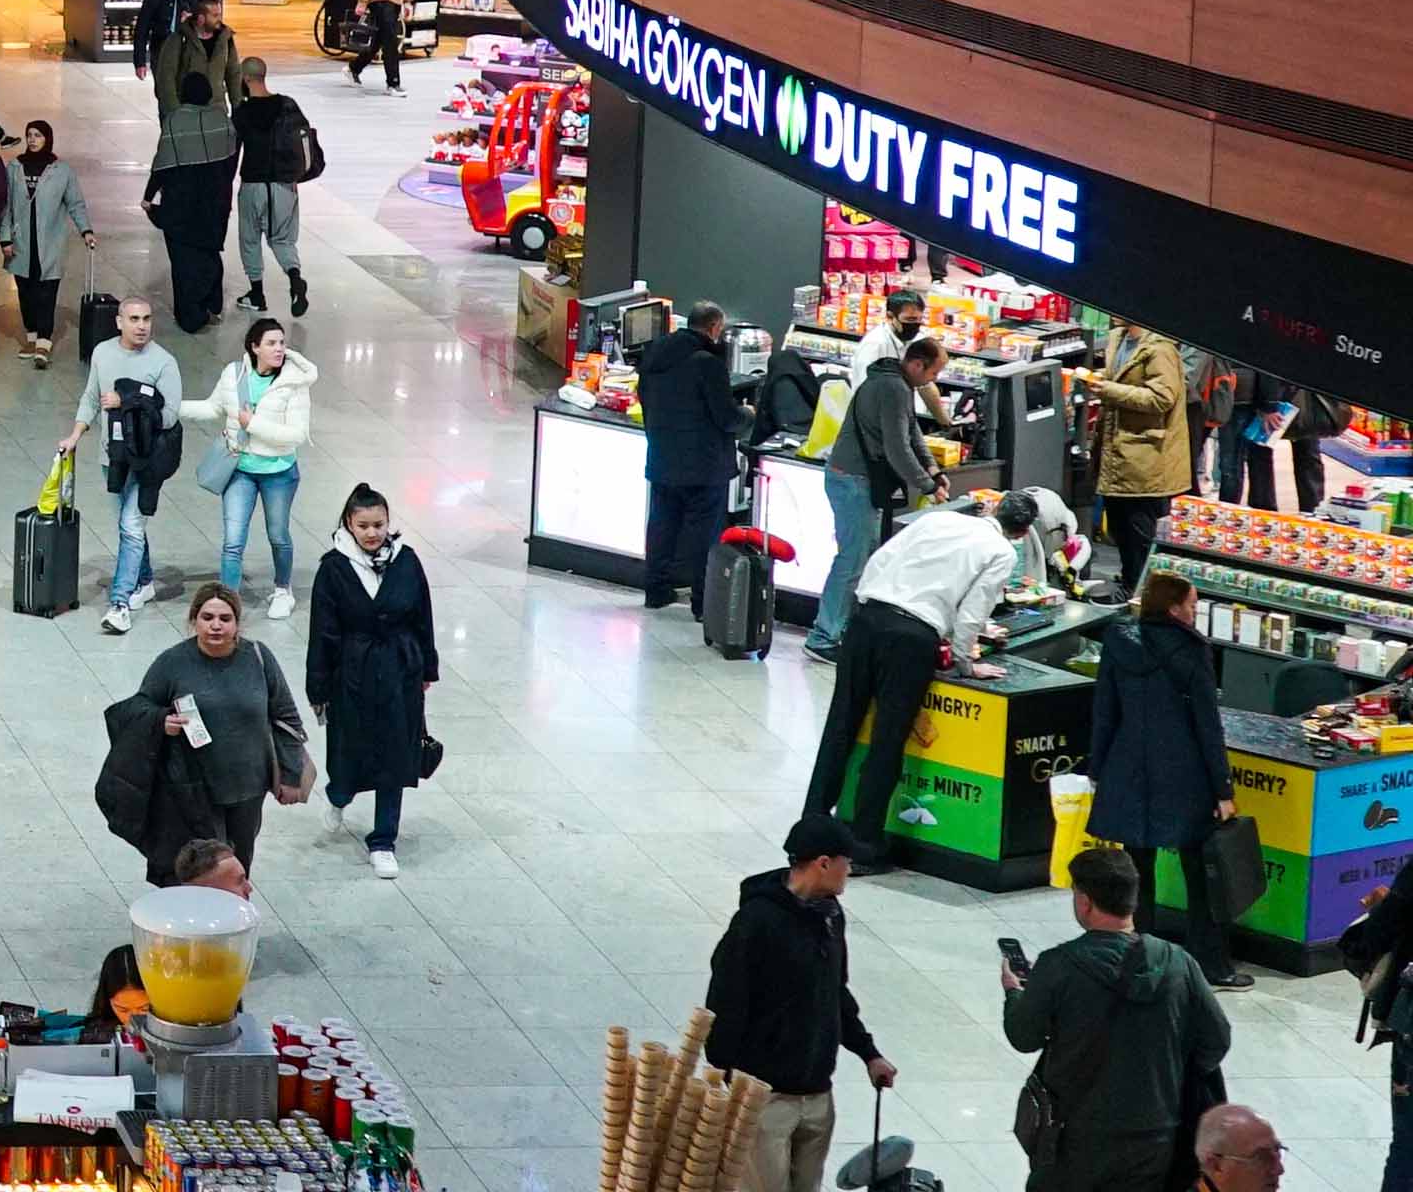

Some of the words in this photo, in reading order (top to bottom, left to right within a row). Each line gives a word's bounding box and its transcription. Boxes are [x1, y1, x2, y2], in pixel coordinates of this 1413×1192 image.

[643, 16, 766, 137] GÖKÇEN
[814, 91, 928, 206] DUTY
[939, 139, 1078, 264] FREE
[1242, 304, 1254, 323] A
[1335, 334, 1383, 364] Store
[923, 692, 983, 721] UNGRY?
[1015, 734, 1056, 756] SNACK
[933, 774, 983, 804] MINT?
[1232, 765, 1287, 796] NGRY?
[1340, 785, 1369, 799] SHARE
[1380, 768, 1413, 792] SNAC
